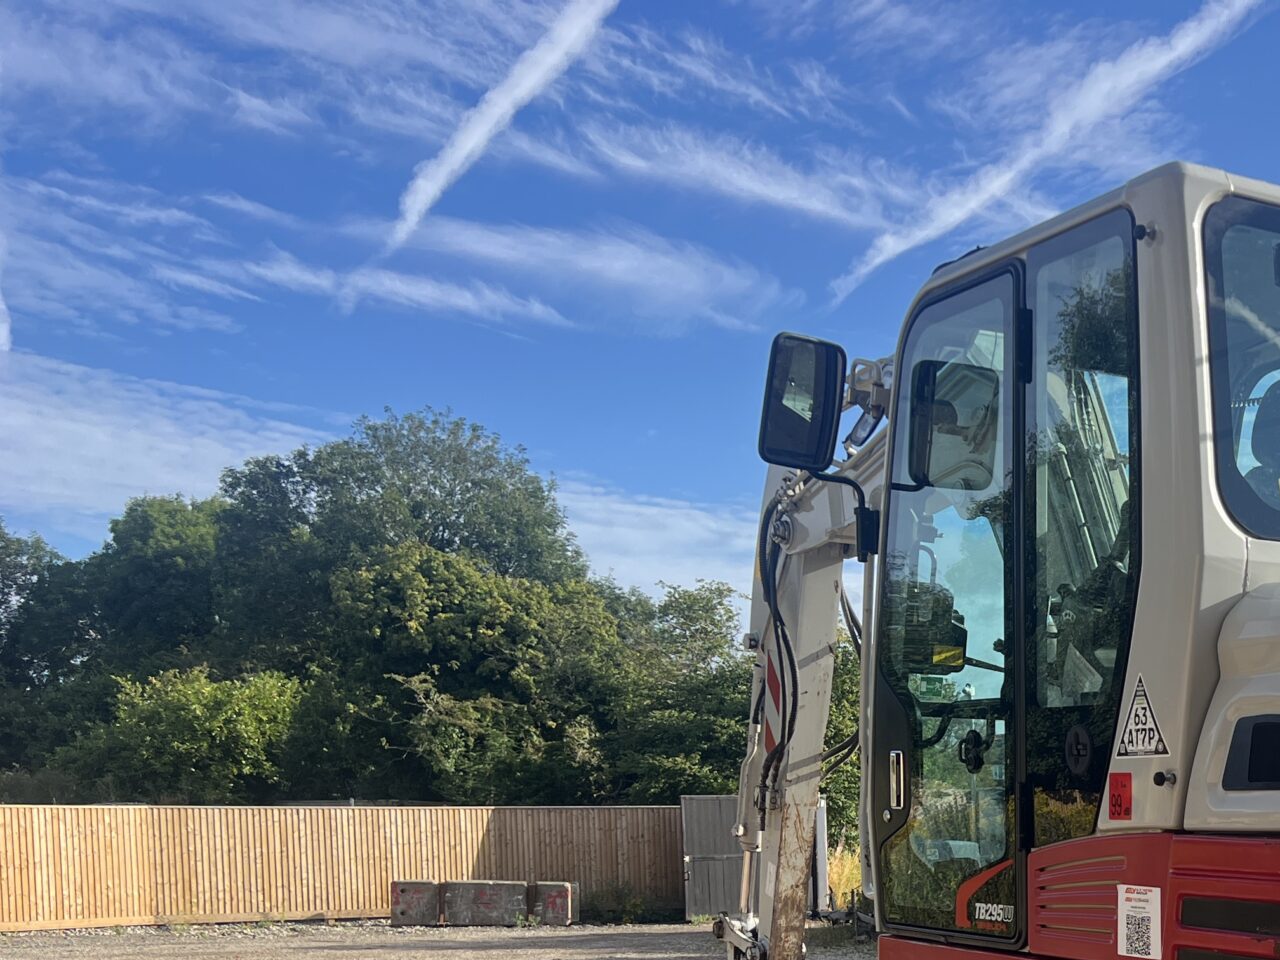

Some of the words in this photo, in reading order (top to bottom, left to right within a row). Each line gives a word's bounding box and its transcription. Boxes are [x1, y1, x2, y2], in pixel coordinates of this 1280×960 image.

[1133, 706, 1148, 726] 63
[1127, 727, 1155, 748] AT7P
[1111, 793, 1122, 816] 99
[974, 902, 1014, 922] TB295W
